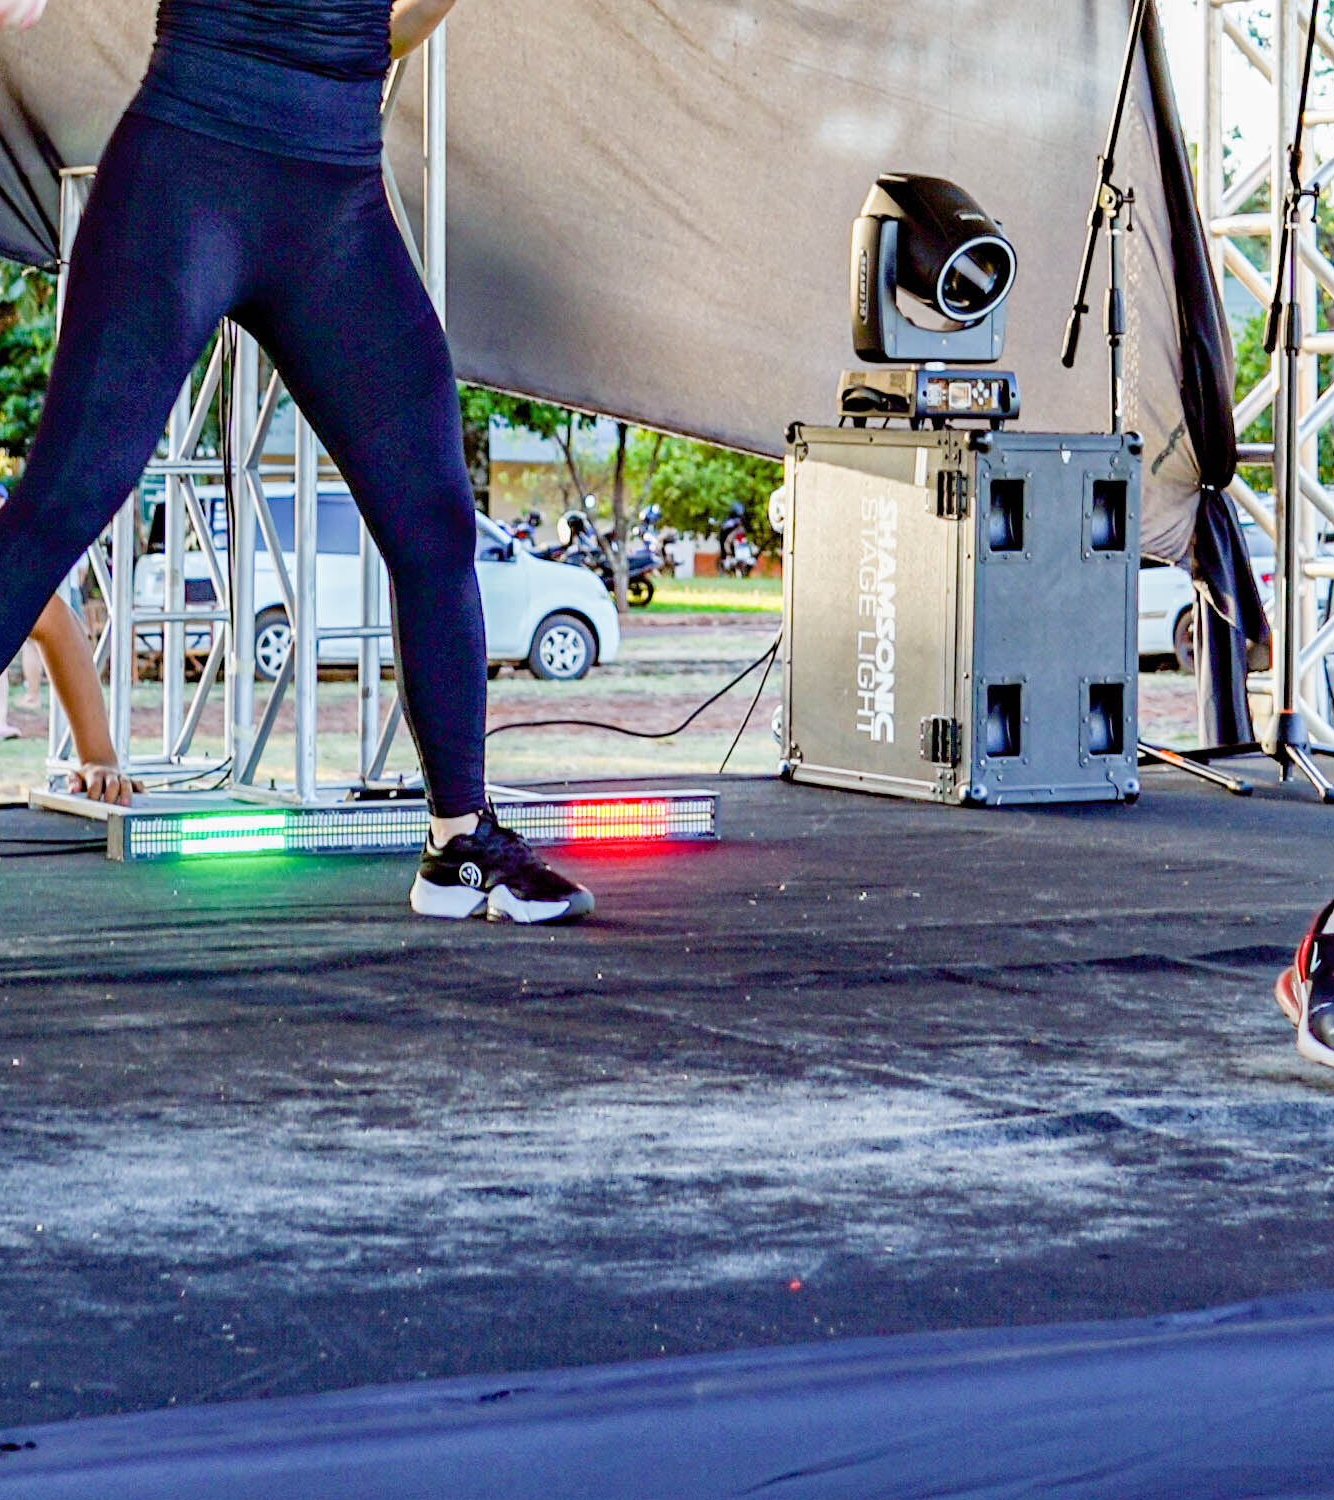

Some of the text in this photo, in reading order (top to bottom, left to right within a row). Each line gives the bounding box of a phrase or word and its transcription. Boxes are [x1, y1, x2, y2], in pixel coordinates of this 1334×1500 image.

[856, 497, 878, 740] STAGE LIGHT
[873, 495, 898, 744] SHAMSONIC
